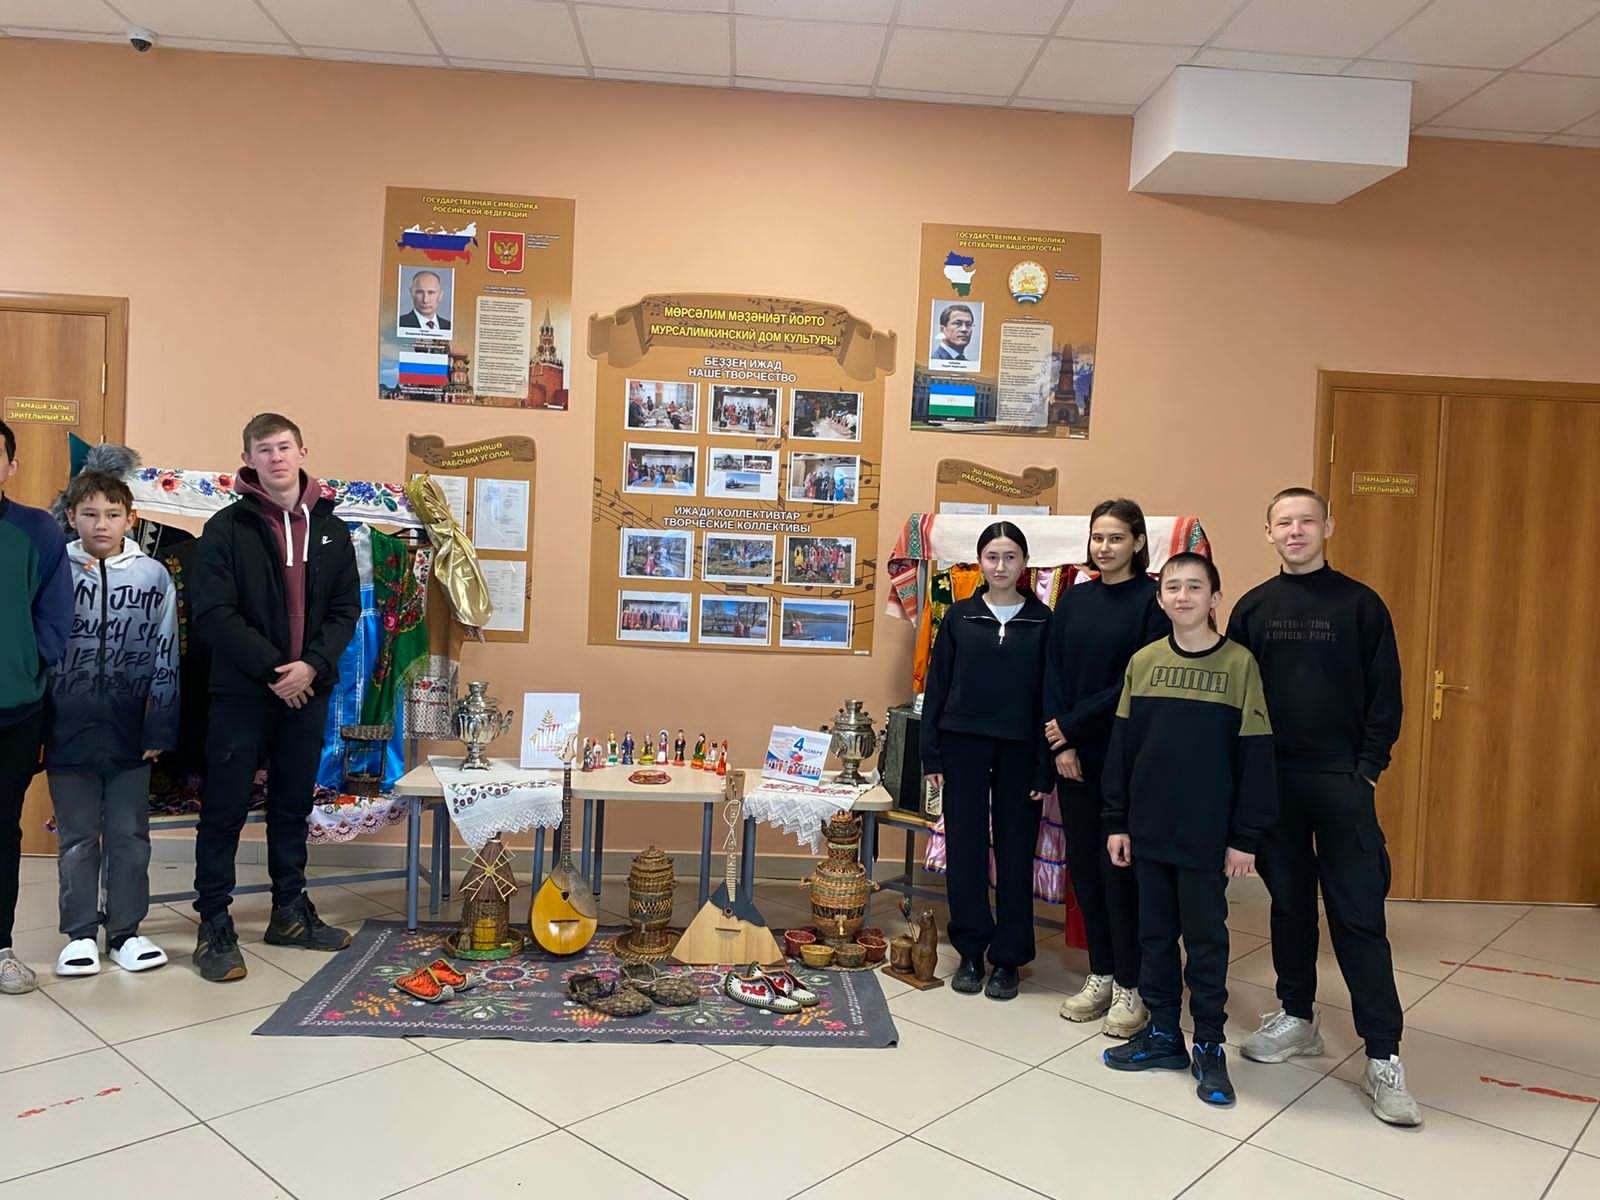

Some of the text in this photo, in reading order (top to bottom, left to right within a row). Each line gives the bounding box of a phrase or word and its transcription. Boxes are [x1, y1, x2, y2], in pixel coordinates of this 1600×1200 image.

[422, 196, 539, 210] ГОСУДАРСТВЕННАЯ СИМВОЛИКА
[432, 206, 529, 218] РОССИЙСКОЙ ФЕДЕРАЦИИ
[956, 231, 1066, 244] ГОСУДАРСТВЕННАЯ СИМВОЛИКА
[959, 240, 1062, 252] РЕСПУБЛИКИ БАШКОРТОСТАН
[664, 306, 726, 320] МӨРСӘЛИМ
[789, 312, 825, 327] ЙОРТО
[650, 324, 837, 346] МУРСАЛИМКИНСКИЙ ДОМ КУЛЬТУРЫ
[749, 359, 783, 371] ИЖАД
[688, 367, 797, 383] НАШЕ ТВОРЧЕСТВО
[442, 450, 511, 467] РАБОЧИЙ УГОЛОК
[674, 506, 801, 521] ИЖАДИ КОЛЛЕКТИВТАР
[664, 517, 811, 533] ТВОРЧЕСКИЕ КОЛЛЕКТИВЫ
[1150, 665, 1229, 693] PUMA
[793, 736, 805, 751] 4
